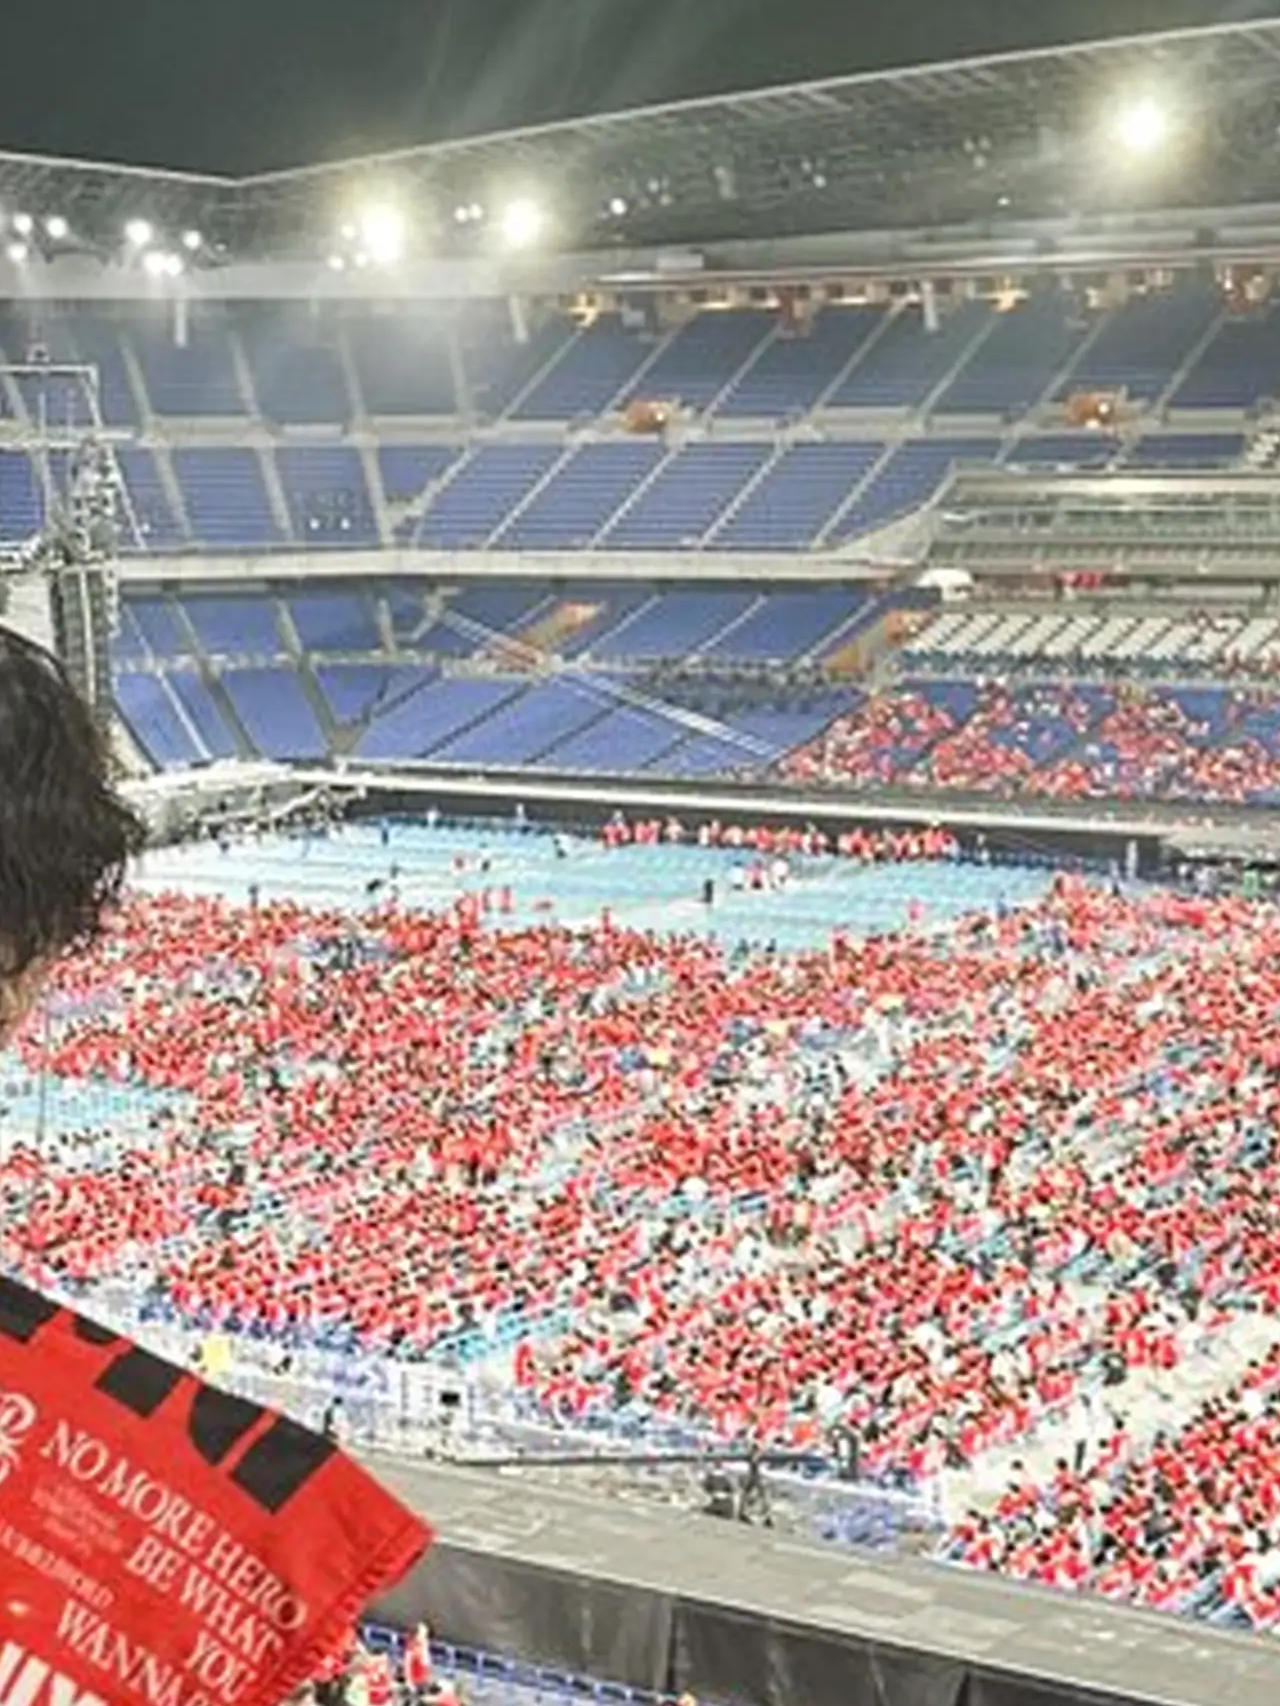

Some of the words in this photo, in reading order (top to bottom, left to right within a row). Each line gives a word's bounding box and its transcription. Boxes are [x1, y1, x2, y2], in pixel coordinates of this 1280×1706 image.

[97, 1456, 216, 1556] MORE
[204, 1530, 310, 1631] HERO
[125, 1534, 186, 1593] BE
[180, 1565, 285, 1665] WHAT
[185, 1629, 258, 1703] YOU
